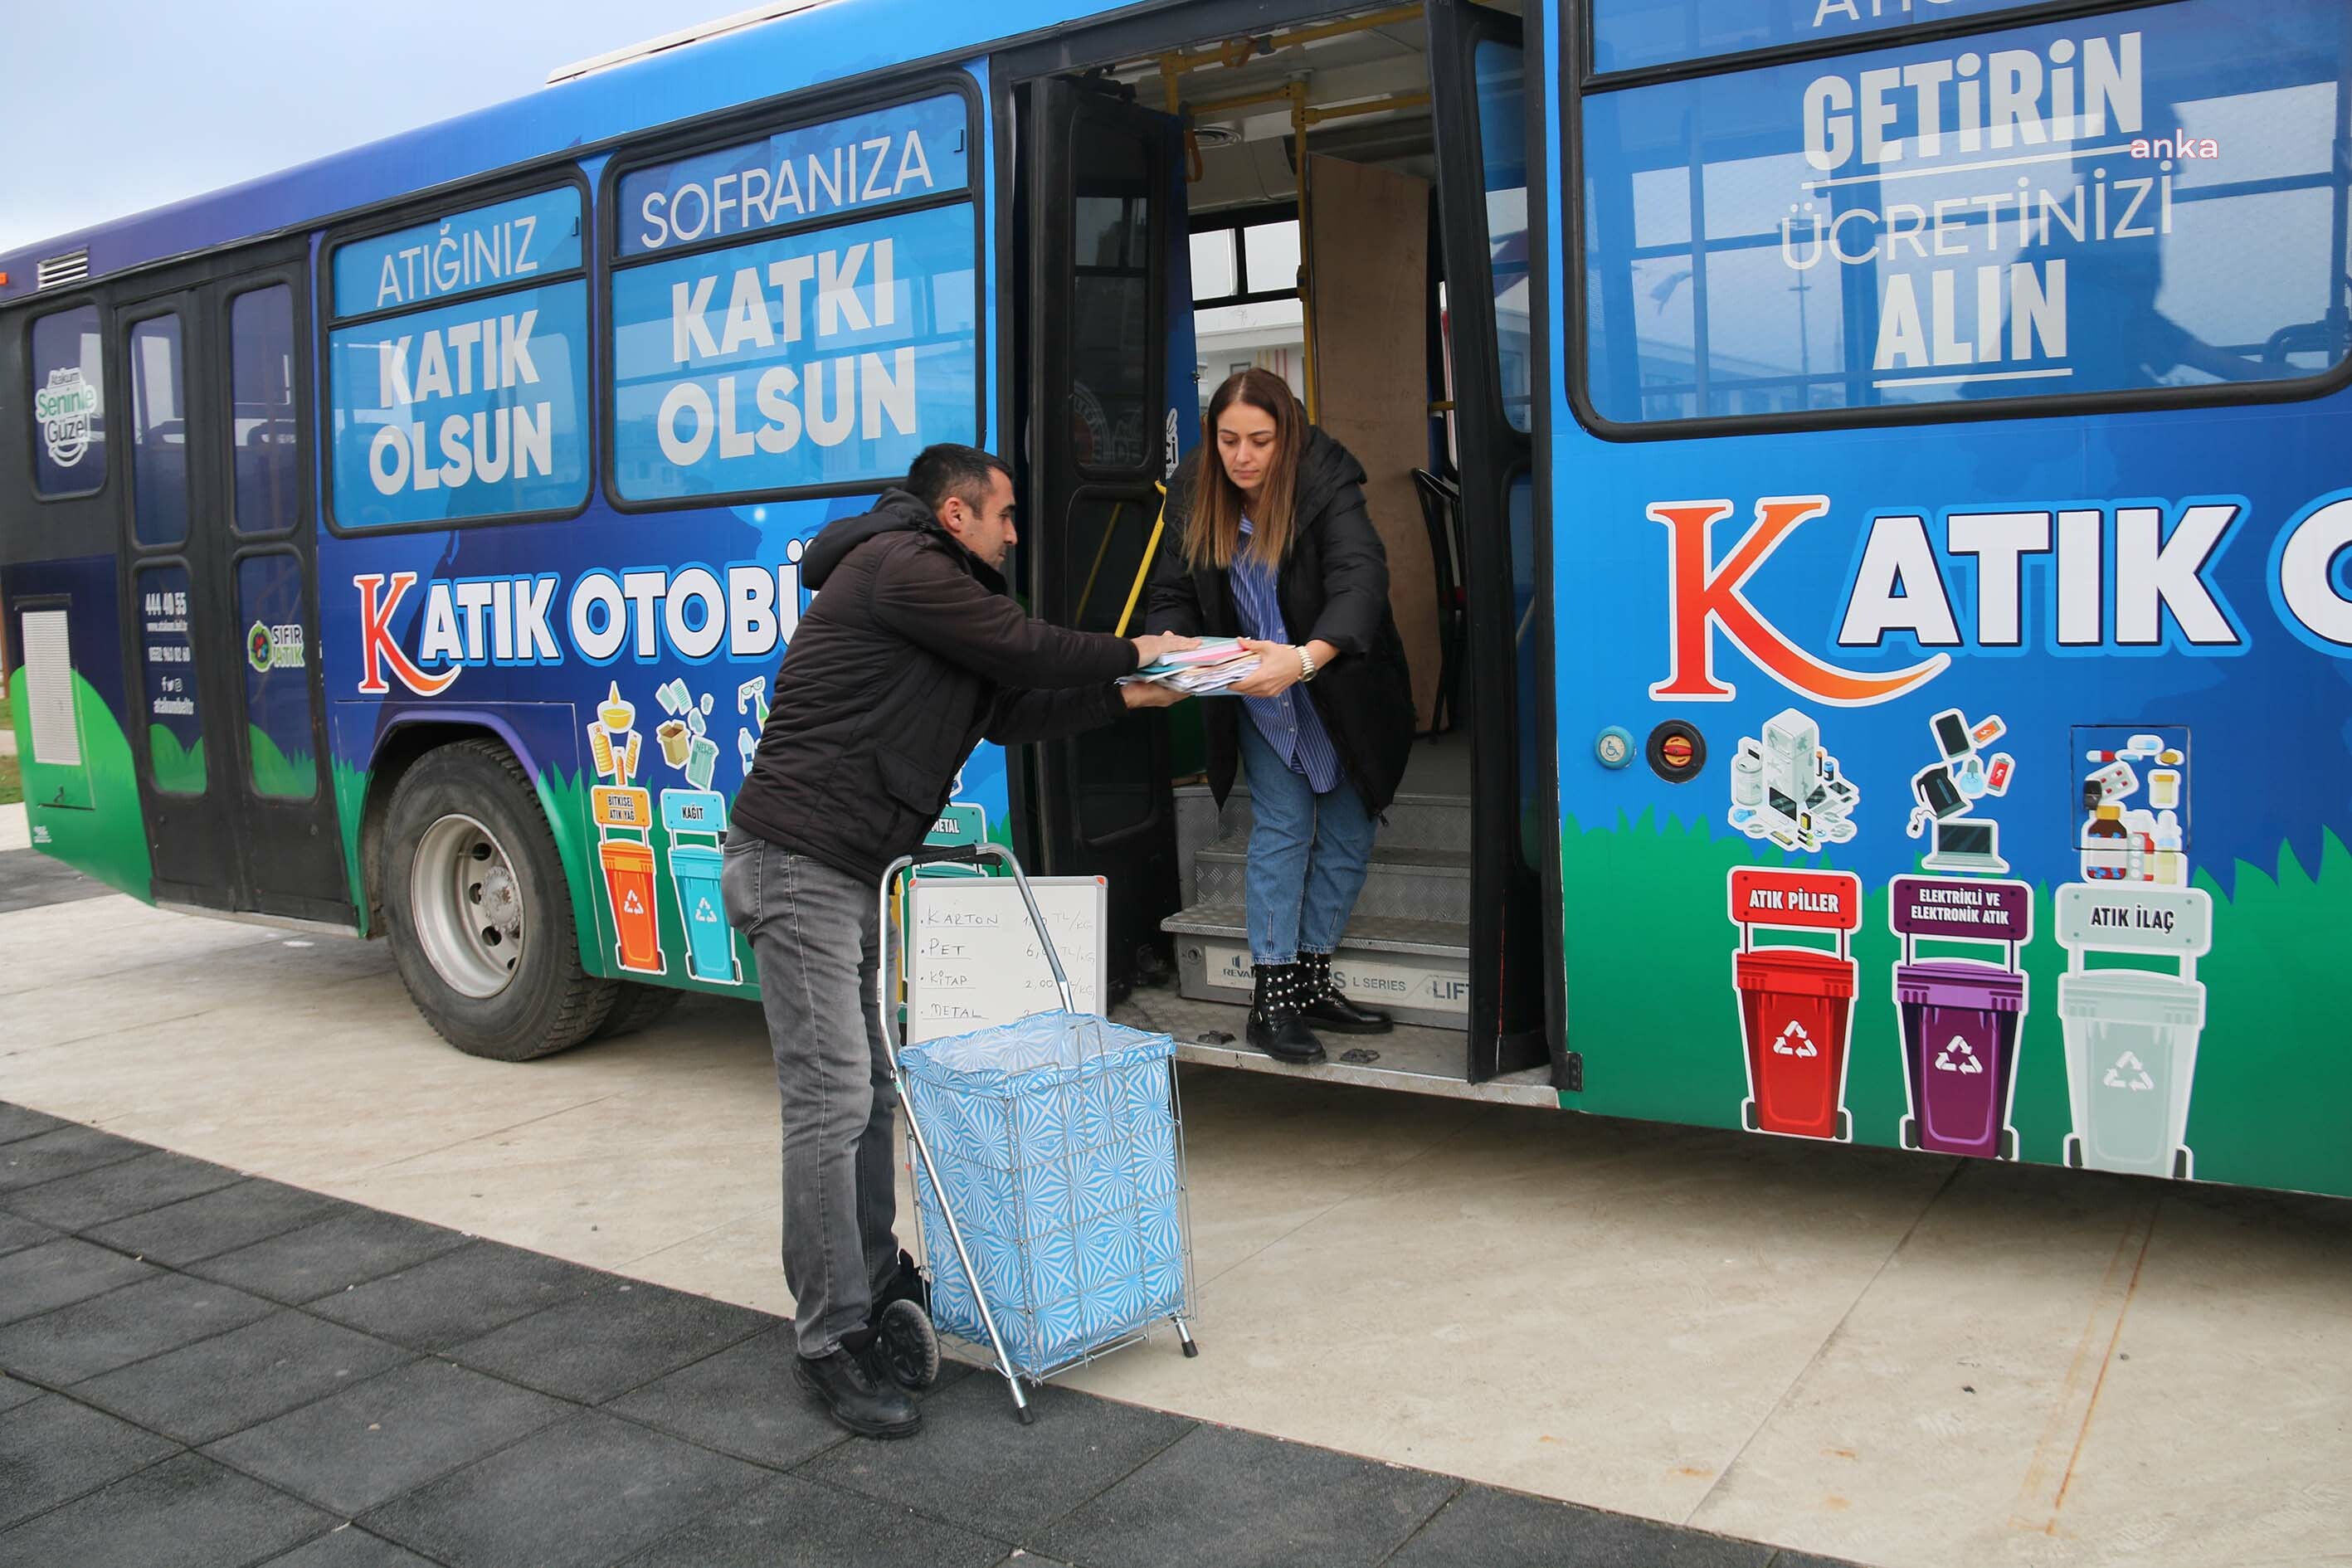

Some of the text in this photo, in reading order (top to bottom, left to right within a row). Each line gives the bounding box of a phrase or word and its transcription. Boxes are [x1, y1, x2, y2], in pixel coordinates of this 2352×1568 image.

[641, 130, 934, 249] SOFRANIZA
[1780, 160, 2172, 270] ÜCRETİNİZİ
[376, 216, 538, 307] ATIĞINIZ
[672, 238, 896, 363] KATKI
[1873, 259, 2067, 370] ALIN
[380, 309, 539, 408] KATIK
[657, 347, 917, 466] OLSUN
[47, 416, 88, 443] Güzel
[369, 402, 552, 495] OLSUN
[1647, 494, 2240, 707] KATIK
[274, 627, 302, 645] SIFIR
[354, 572, 561, 696] KATIK
[275, 646, 304, 666] ATIK
[609, 808, 622, 819] ATIK
[682, 803, 704, 820] KAĞIT
[1749, 887, 1840, 913] ATIK PİLLER
[1919, 887, 2001, 908] ELEKTRİKLİ VE
[928, 906, 998, 925] KARTON
[1911, 904, 2009, 926] ELEKTRONİK ATIK
[2091, 904, 2174, 933] ATIK İLAÇ
[929, 937, 965, 956] PET
[1025, 979, 1054, 991] 2,00
[1353, 976, 1360, 987] L
[1363, 977, 1406, 991] SERIES
[1434, 981, 1469, 1001] LIF
[930, 1003, 983, 1018] METAL
